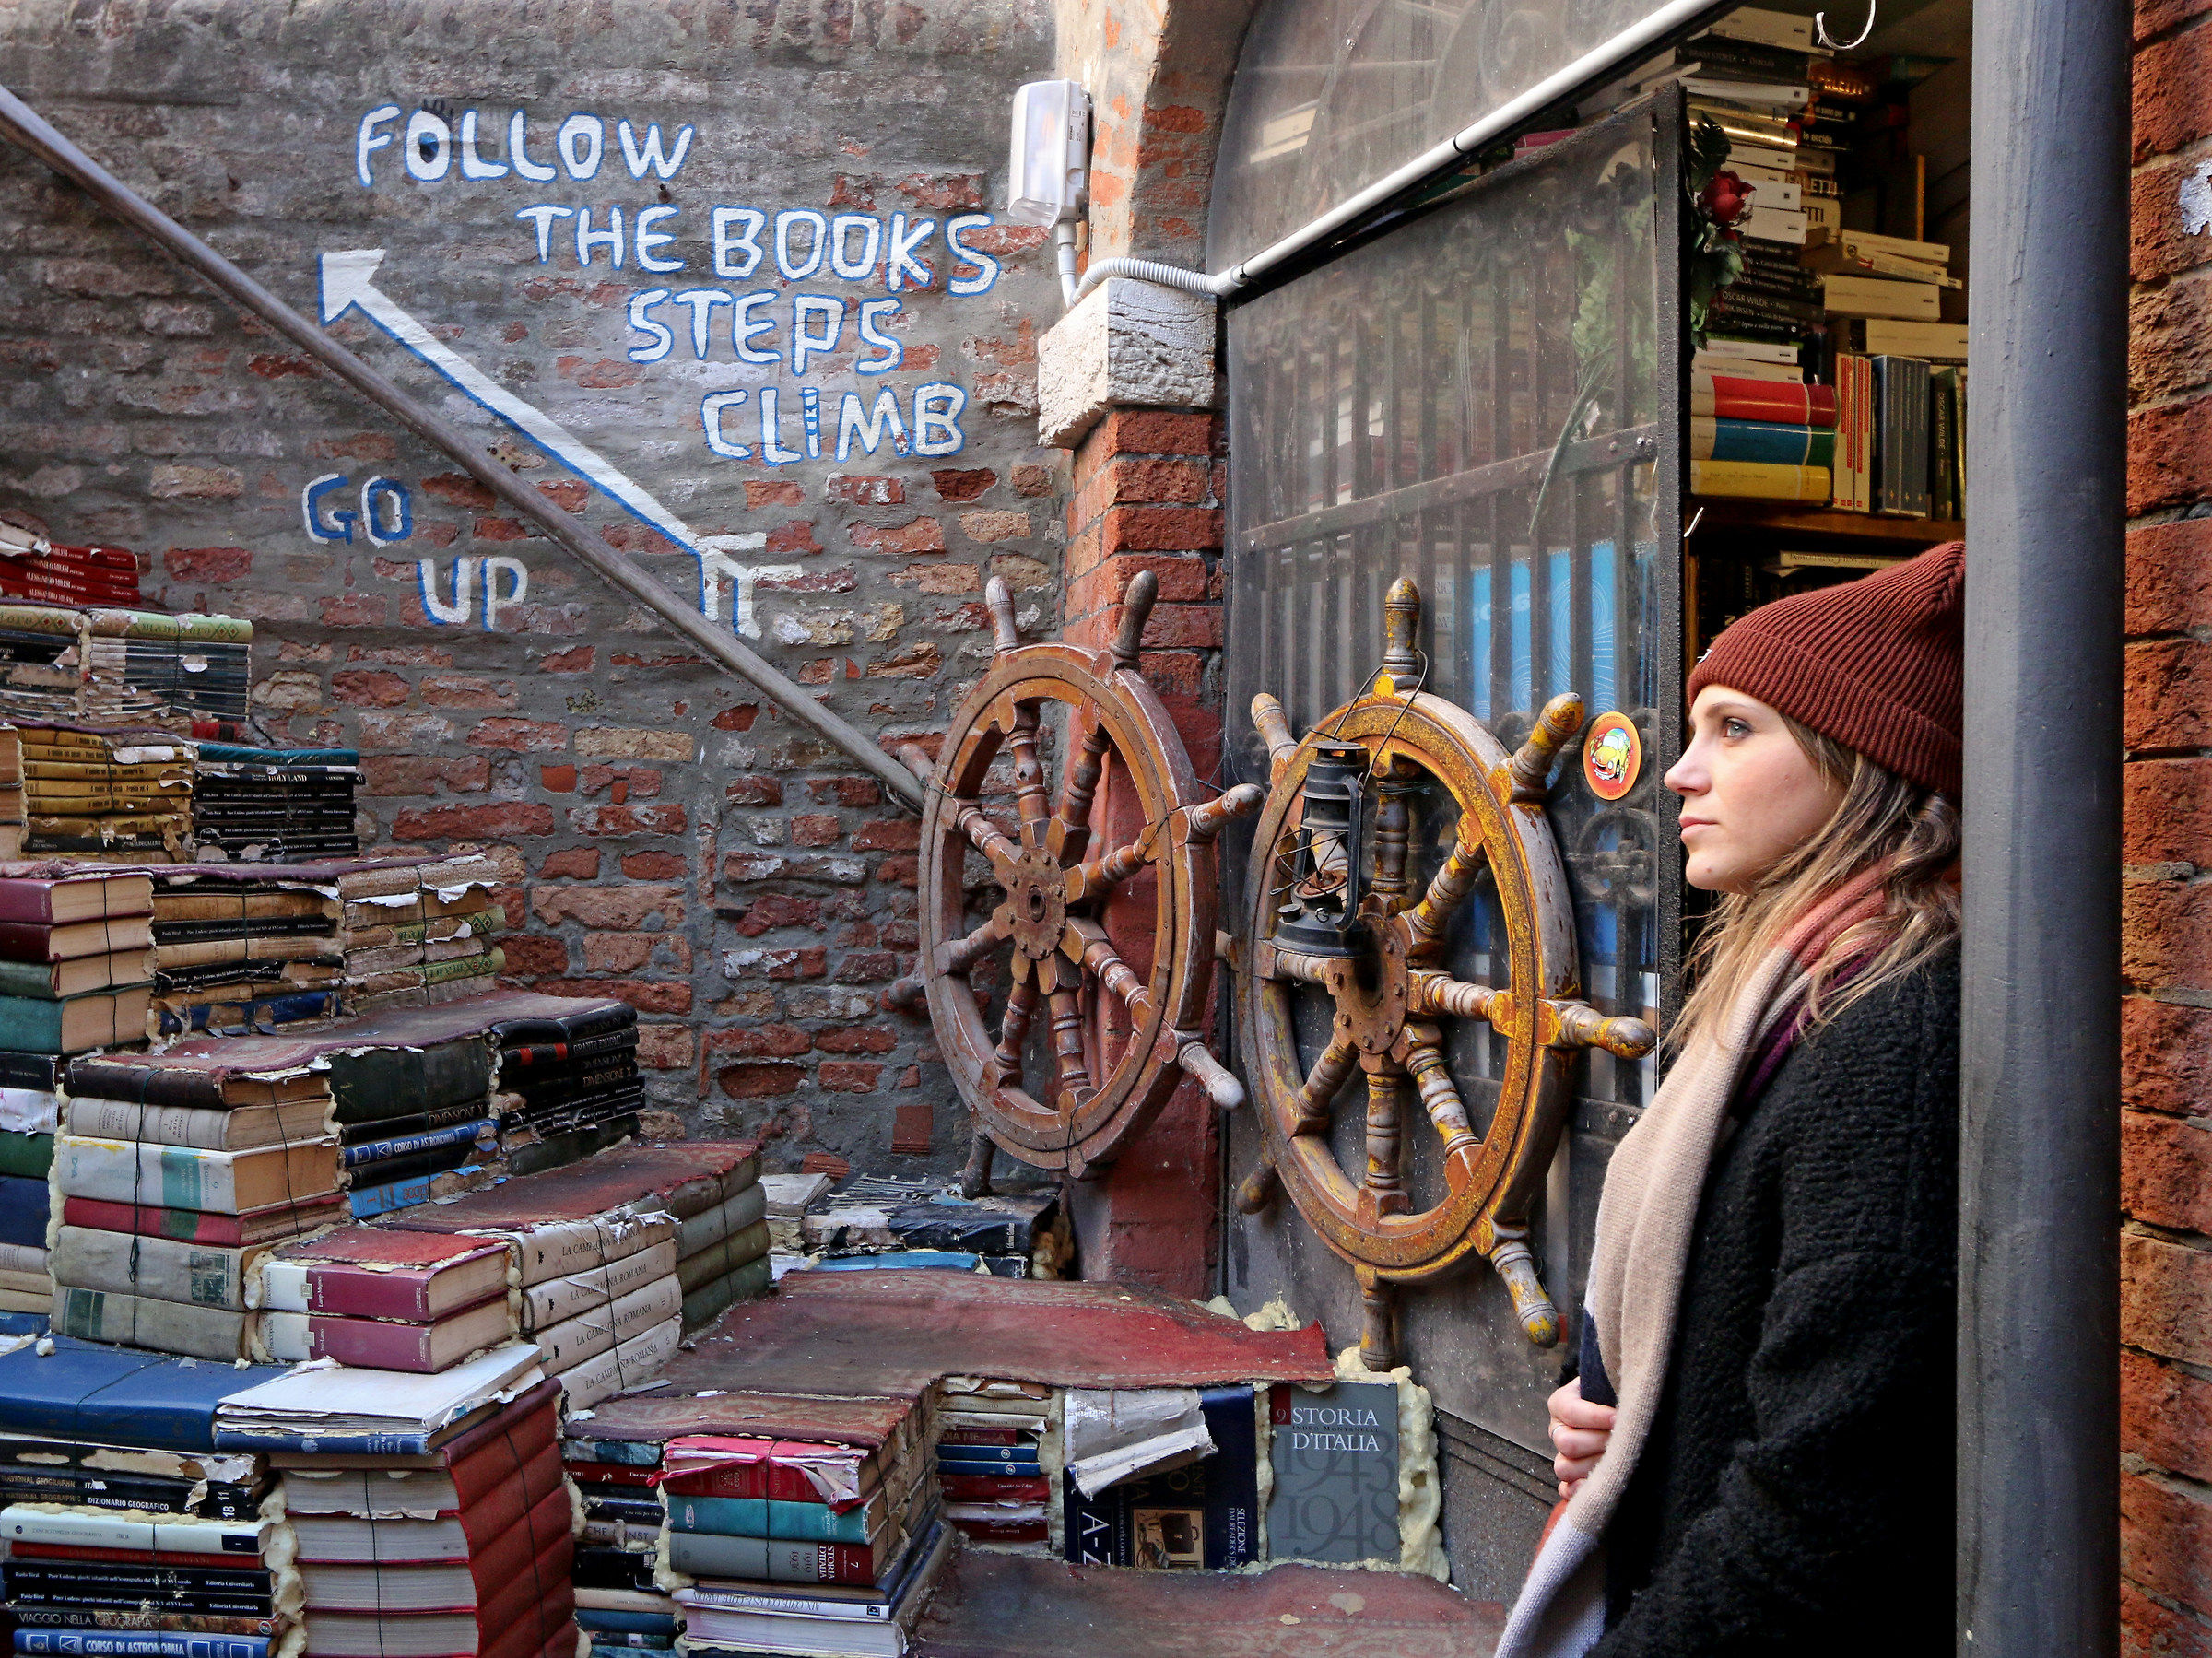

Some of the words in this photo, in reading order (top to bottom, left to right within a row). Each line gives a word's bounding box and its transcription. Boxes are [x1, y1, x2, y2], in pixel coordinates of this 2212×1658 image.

[358, 103, 695, 186] FOLLOW
[517, 204, 683, 275] THE
[710, 205, 1001, 297] BOOKS
[627, 288, 904, 376] STEPS
[700, 382, 968, 466] CLIMB
[302, 473, 413, 548] GO
[418, 556, 529, 631] UP
[394, 1141, 412, 1153] CORSO
[562, 1246, 573, 1256] LA
[571, 1290, 580, 1301] LA
[619, 1264, 648, 1283] ROMANA
[575, 1334, 585, 1346] LA
[624, 1303, 652, 1324] ROMANA
[585, 1379, 595, 1390] LA
[596, 1359, 630, 1384] CAMPAGNA
[631, 1344, 658, 1364] ROMANA
[1277, 1408, 1287, 1423] 9
[1292, 1406, 1380, 1426] STORIA
[1292, 1432, 1380, 1452] D'ITALIA
[88, 1497, 126, 1508] DIZIONARIO
[127, 1500, 170, 1511] GEOGRAFICO
[222, 1505, 236, 1518] 18
[1236, 1507, 1246, 1554] SELEZIONE
[1277, 1490, 1400, 1560] 1948
[827, 1546, 835, 1580] STORIA
[18, 1613, 62, 1624] VIAGGIO
[64, 1614, 93, 1625] NELLA
[86, 1640, 113, 1652] CORSO
[116, 1640, 126, 1652] DI
[127, 1641, 185, 1656] ASTRONOMIA
